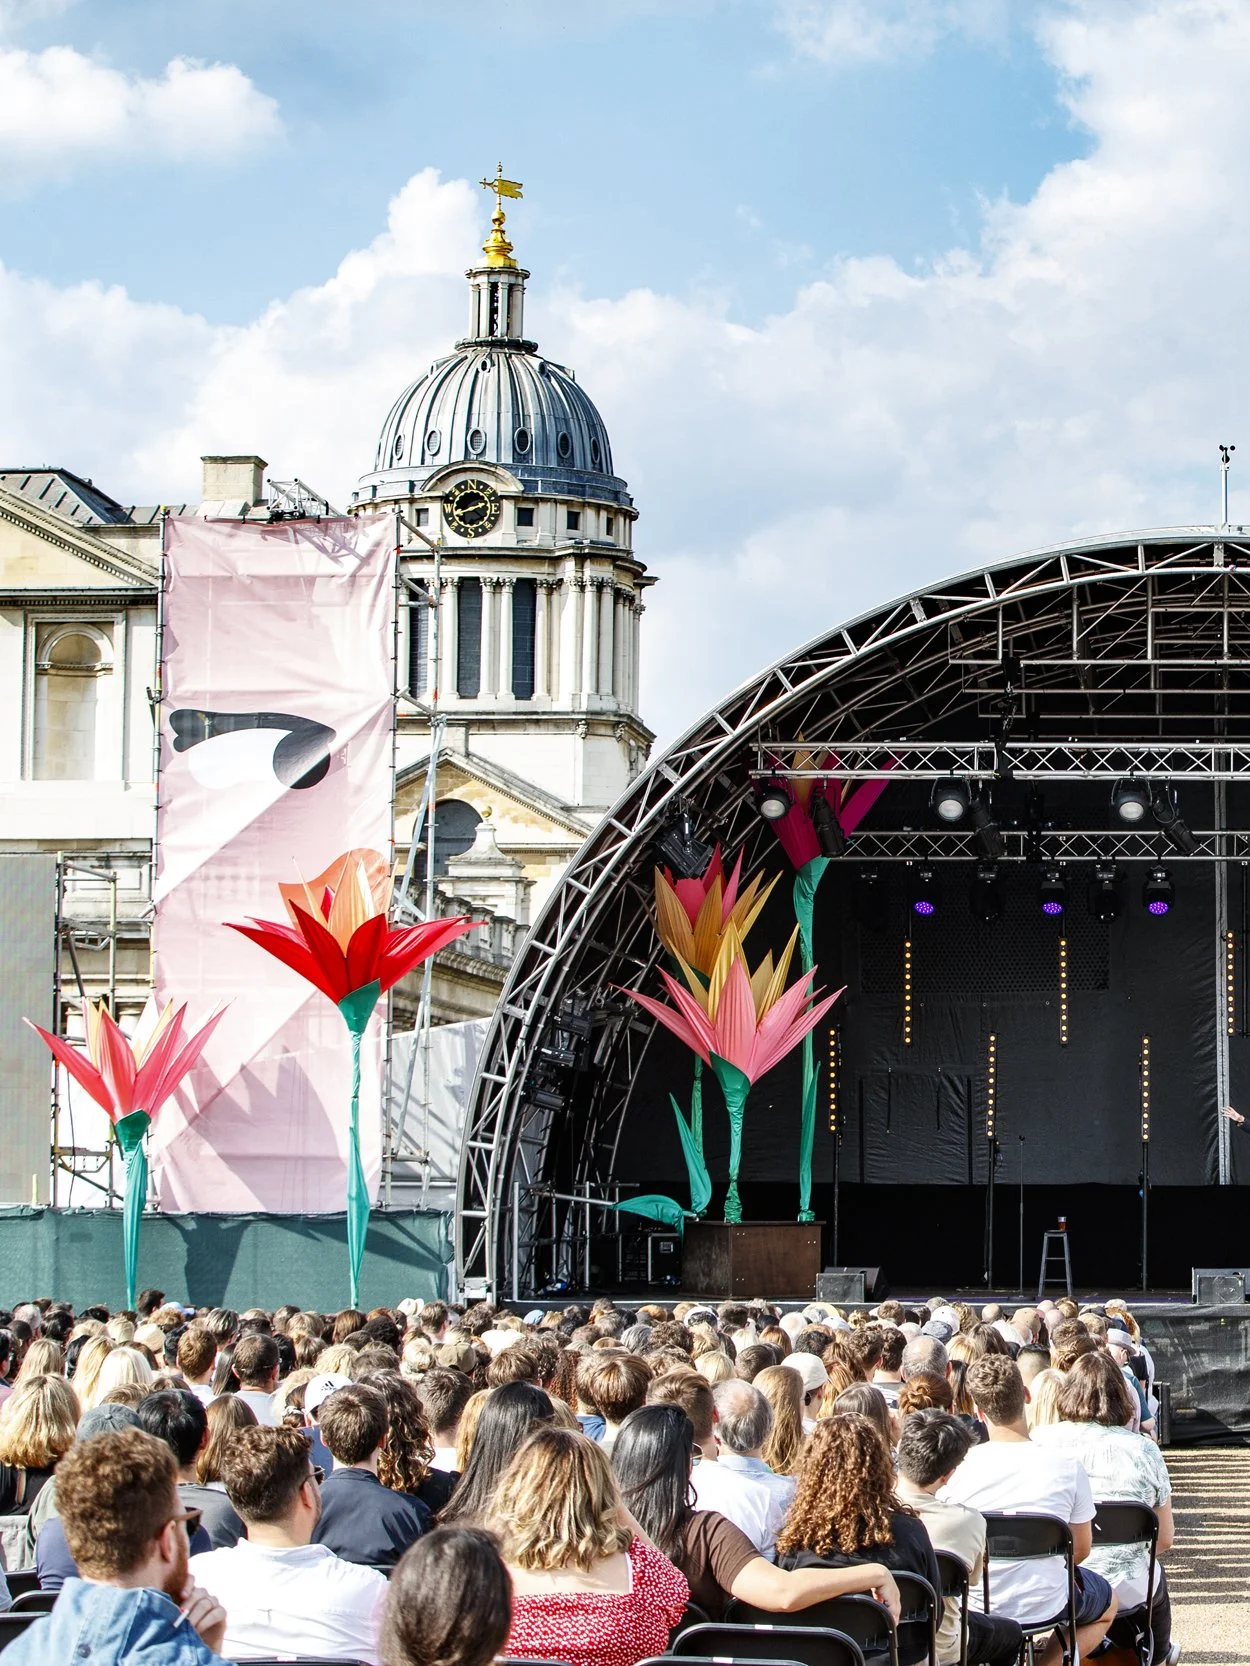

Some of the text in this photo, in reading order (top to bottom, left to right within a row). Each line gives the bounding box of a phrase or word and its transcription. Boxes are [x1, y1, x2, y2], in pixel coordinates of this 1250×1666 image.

[468, 480, 477, 490] N
[443, 503, 454, 514] W
[491, 503, 500, 515] E
[467, 527, 475, 538] S
